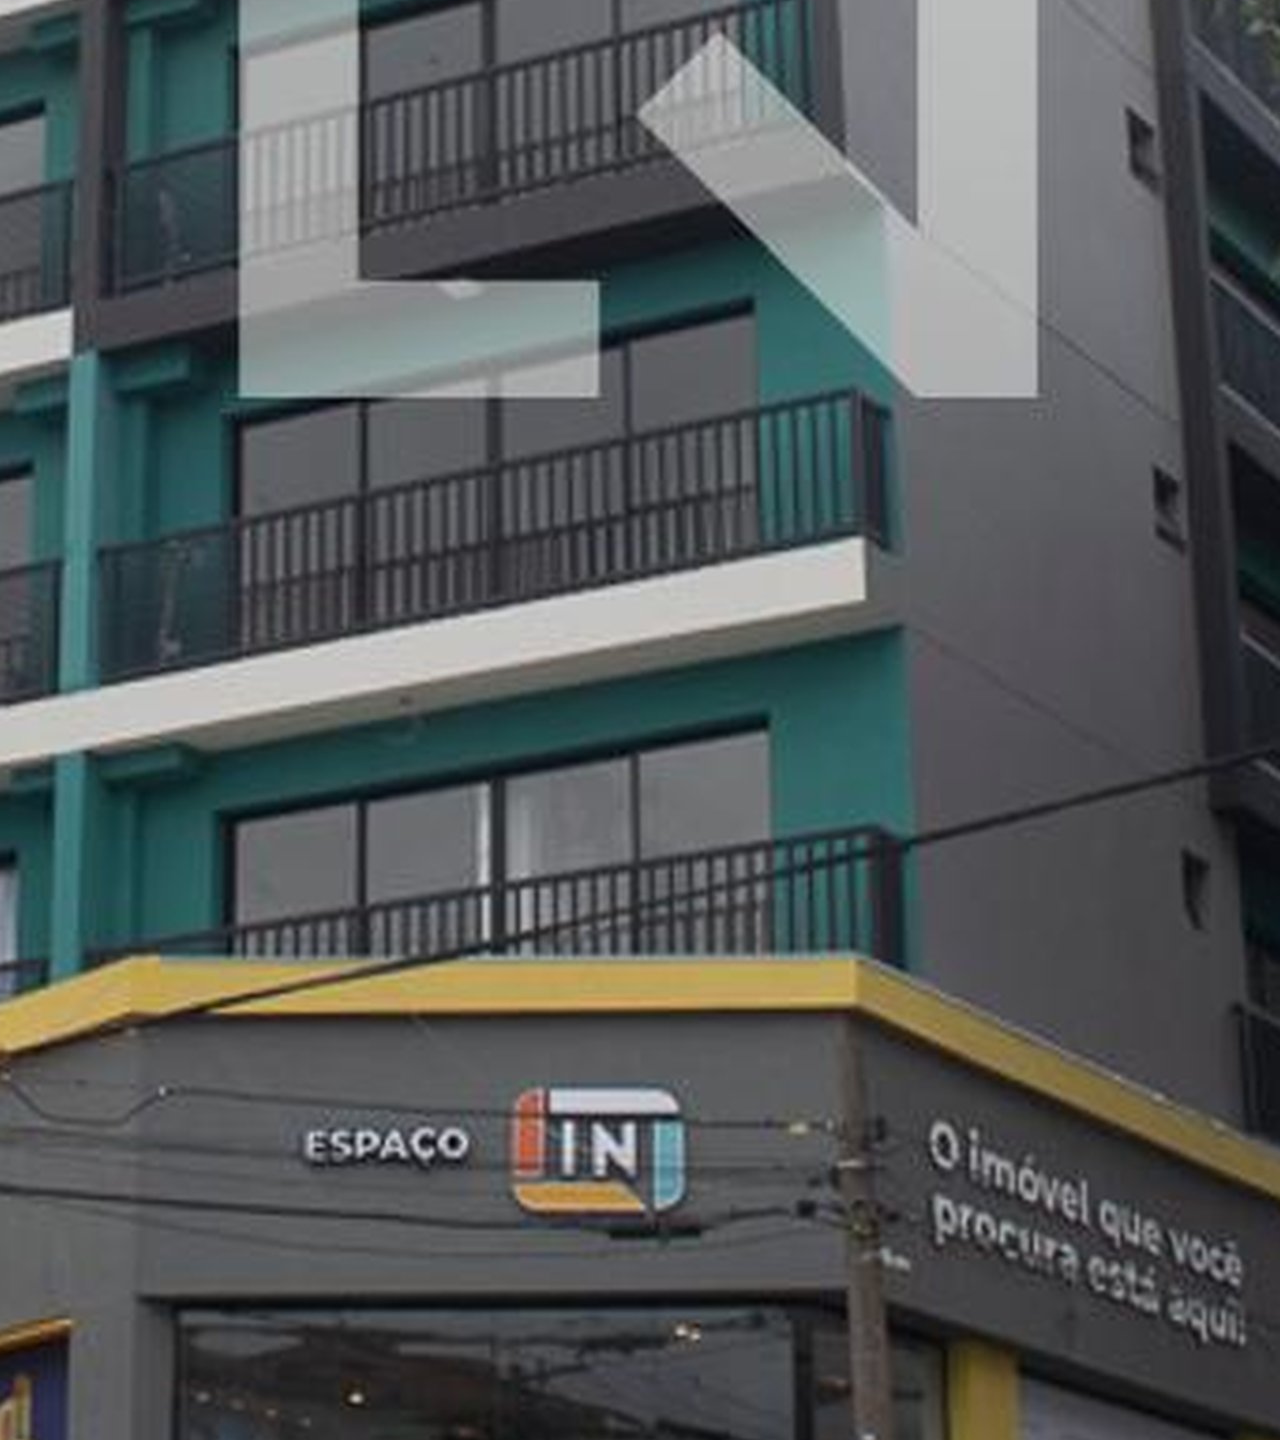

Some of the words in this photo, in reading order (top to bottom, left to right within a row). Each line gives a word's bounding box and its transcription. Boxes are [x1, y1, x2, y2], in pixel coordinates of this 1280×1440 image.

[304, 1126, 470, 1167] ESPAÇO
[561, 1119, 637, 1177] IN
[929, 1120, 960, 1170] O
[969, 1128, 1089, 1225] imóvel
[1098, 1200, 1162, 1256] que
[1169, 1228, 1243, 1287] você
[933, 1193, 1079, 1282] procura
[1087, 1255, 1161, 1313] está
